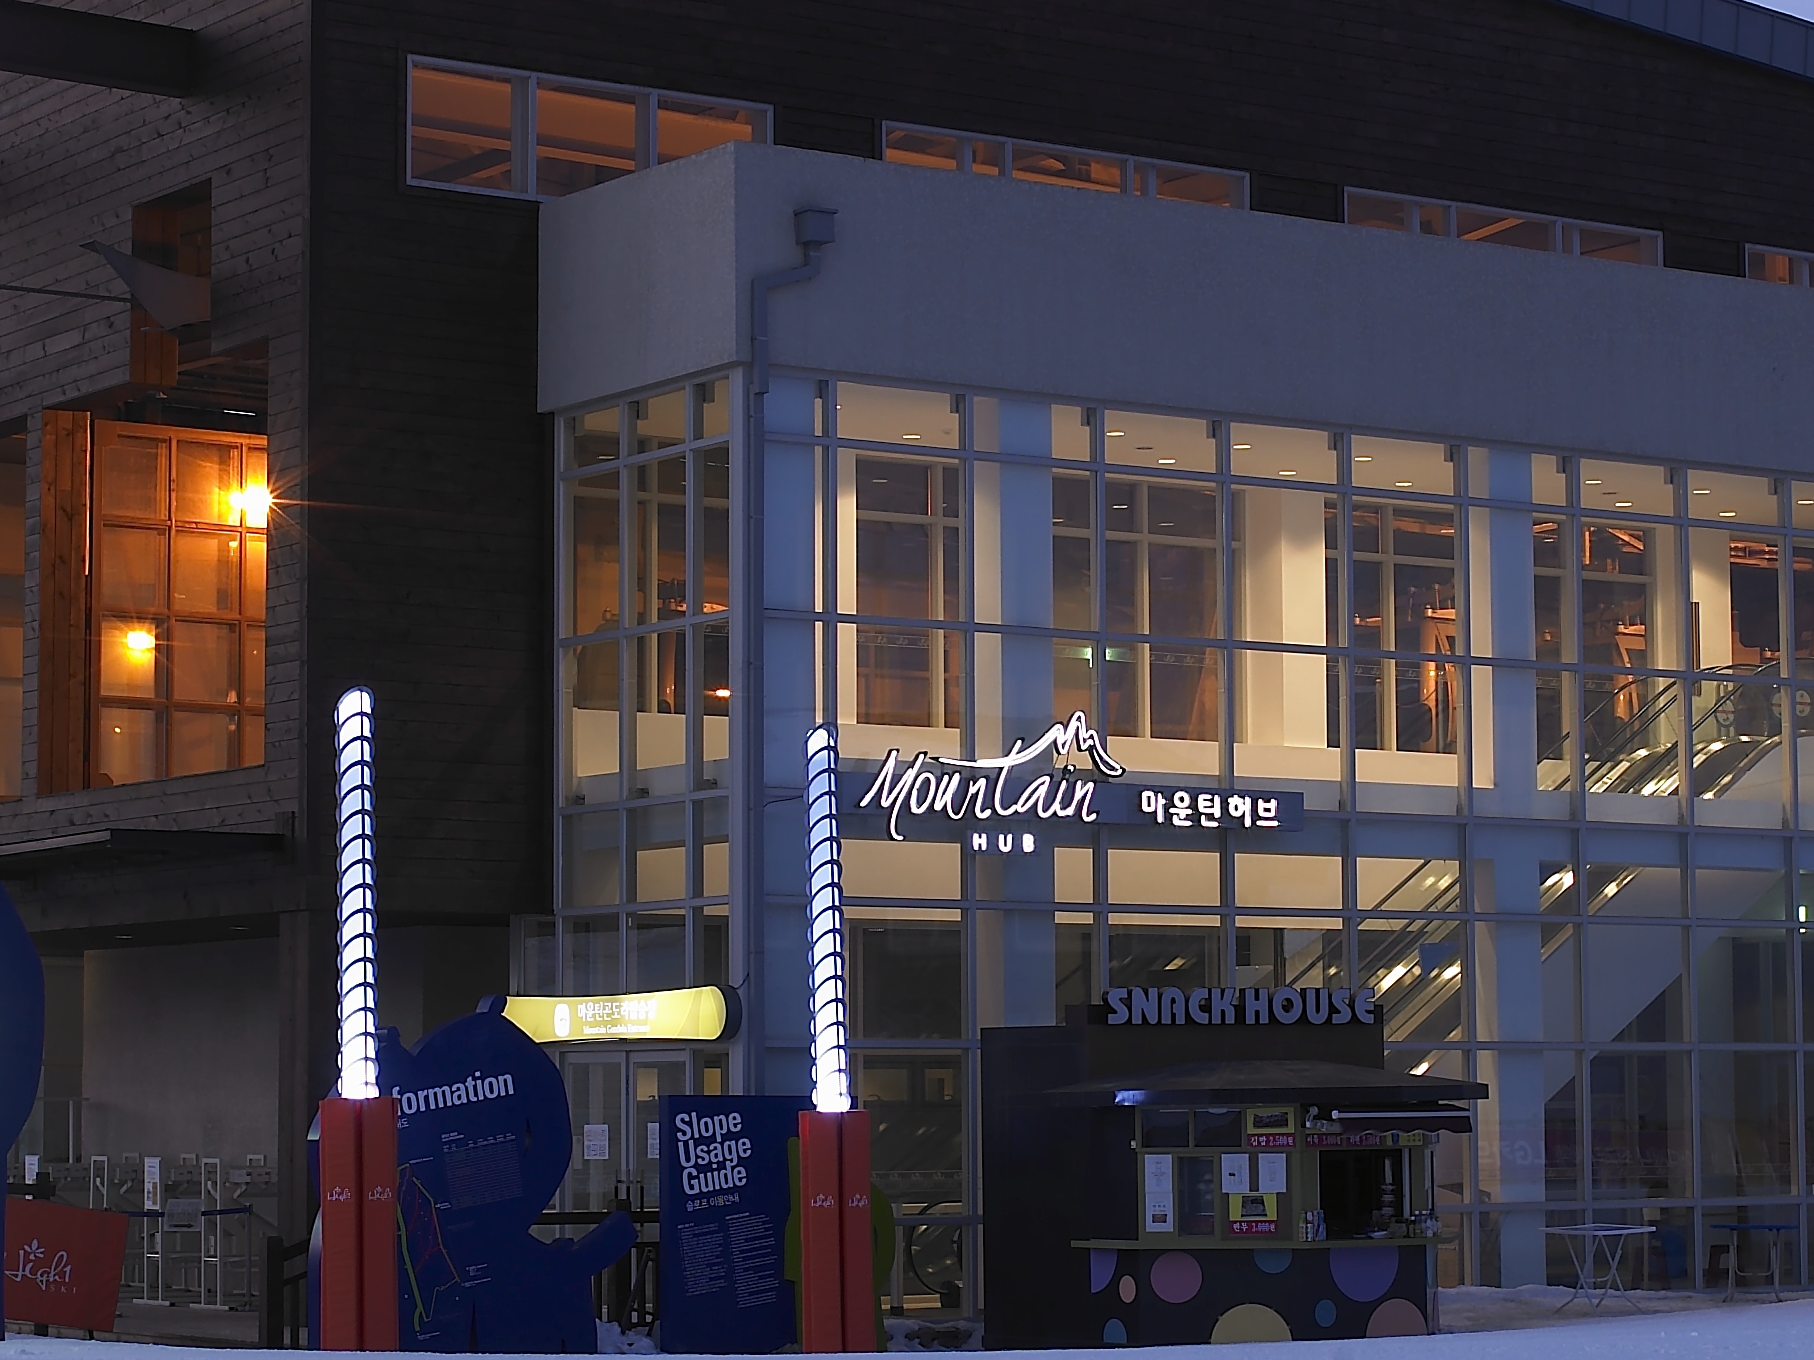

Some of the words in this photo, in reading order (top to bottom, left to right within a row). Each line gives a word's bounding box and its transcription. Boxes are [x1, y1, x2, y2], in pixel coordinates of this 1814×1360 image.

[860, 728, 1099, 841] Mountain
[1141, 790, 1281, 828] 마운틴허브
[972, 832, 1037, 854] HUB
[1106, 985, 1236, 1025] SNACK
[1244, 985, 1376, 1025] HOUSE
[675, 1111, 743, 1142] Slope
[677, 1137, 752, 1168] Usage
[682, 1161, 747, 1195] Guide
